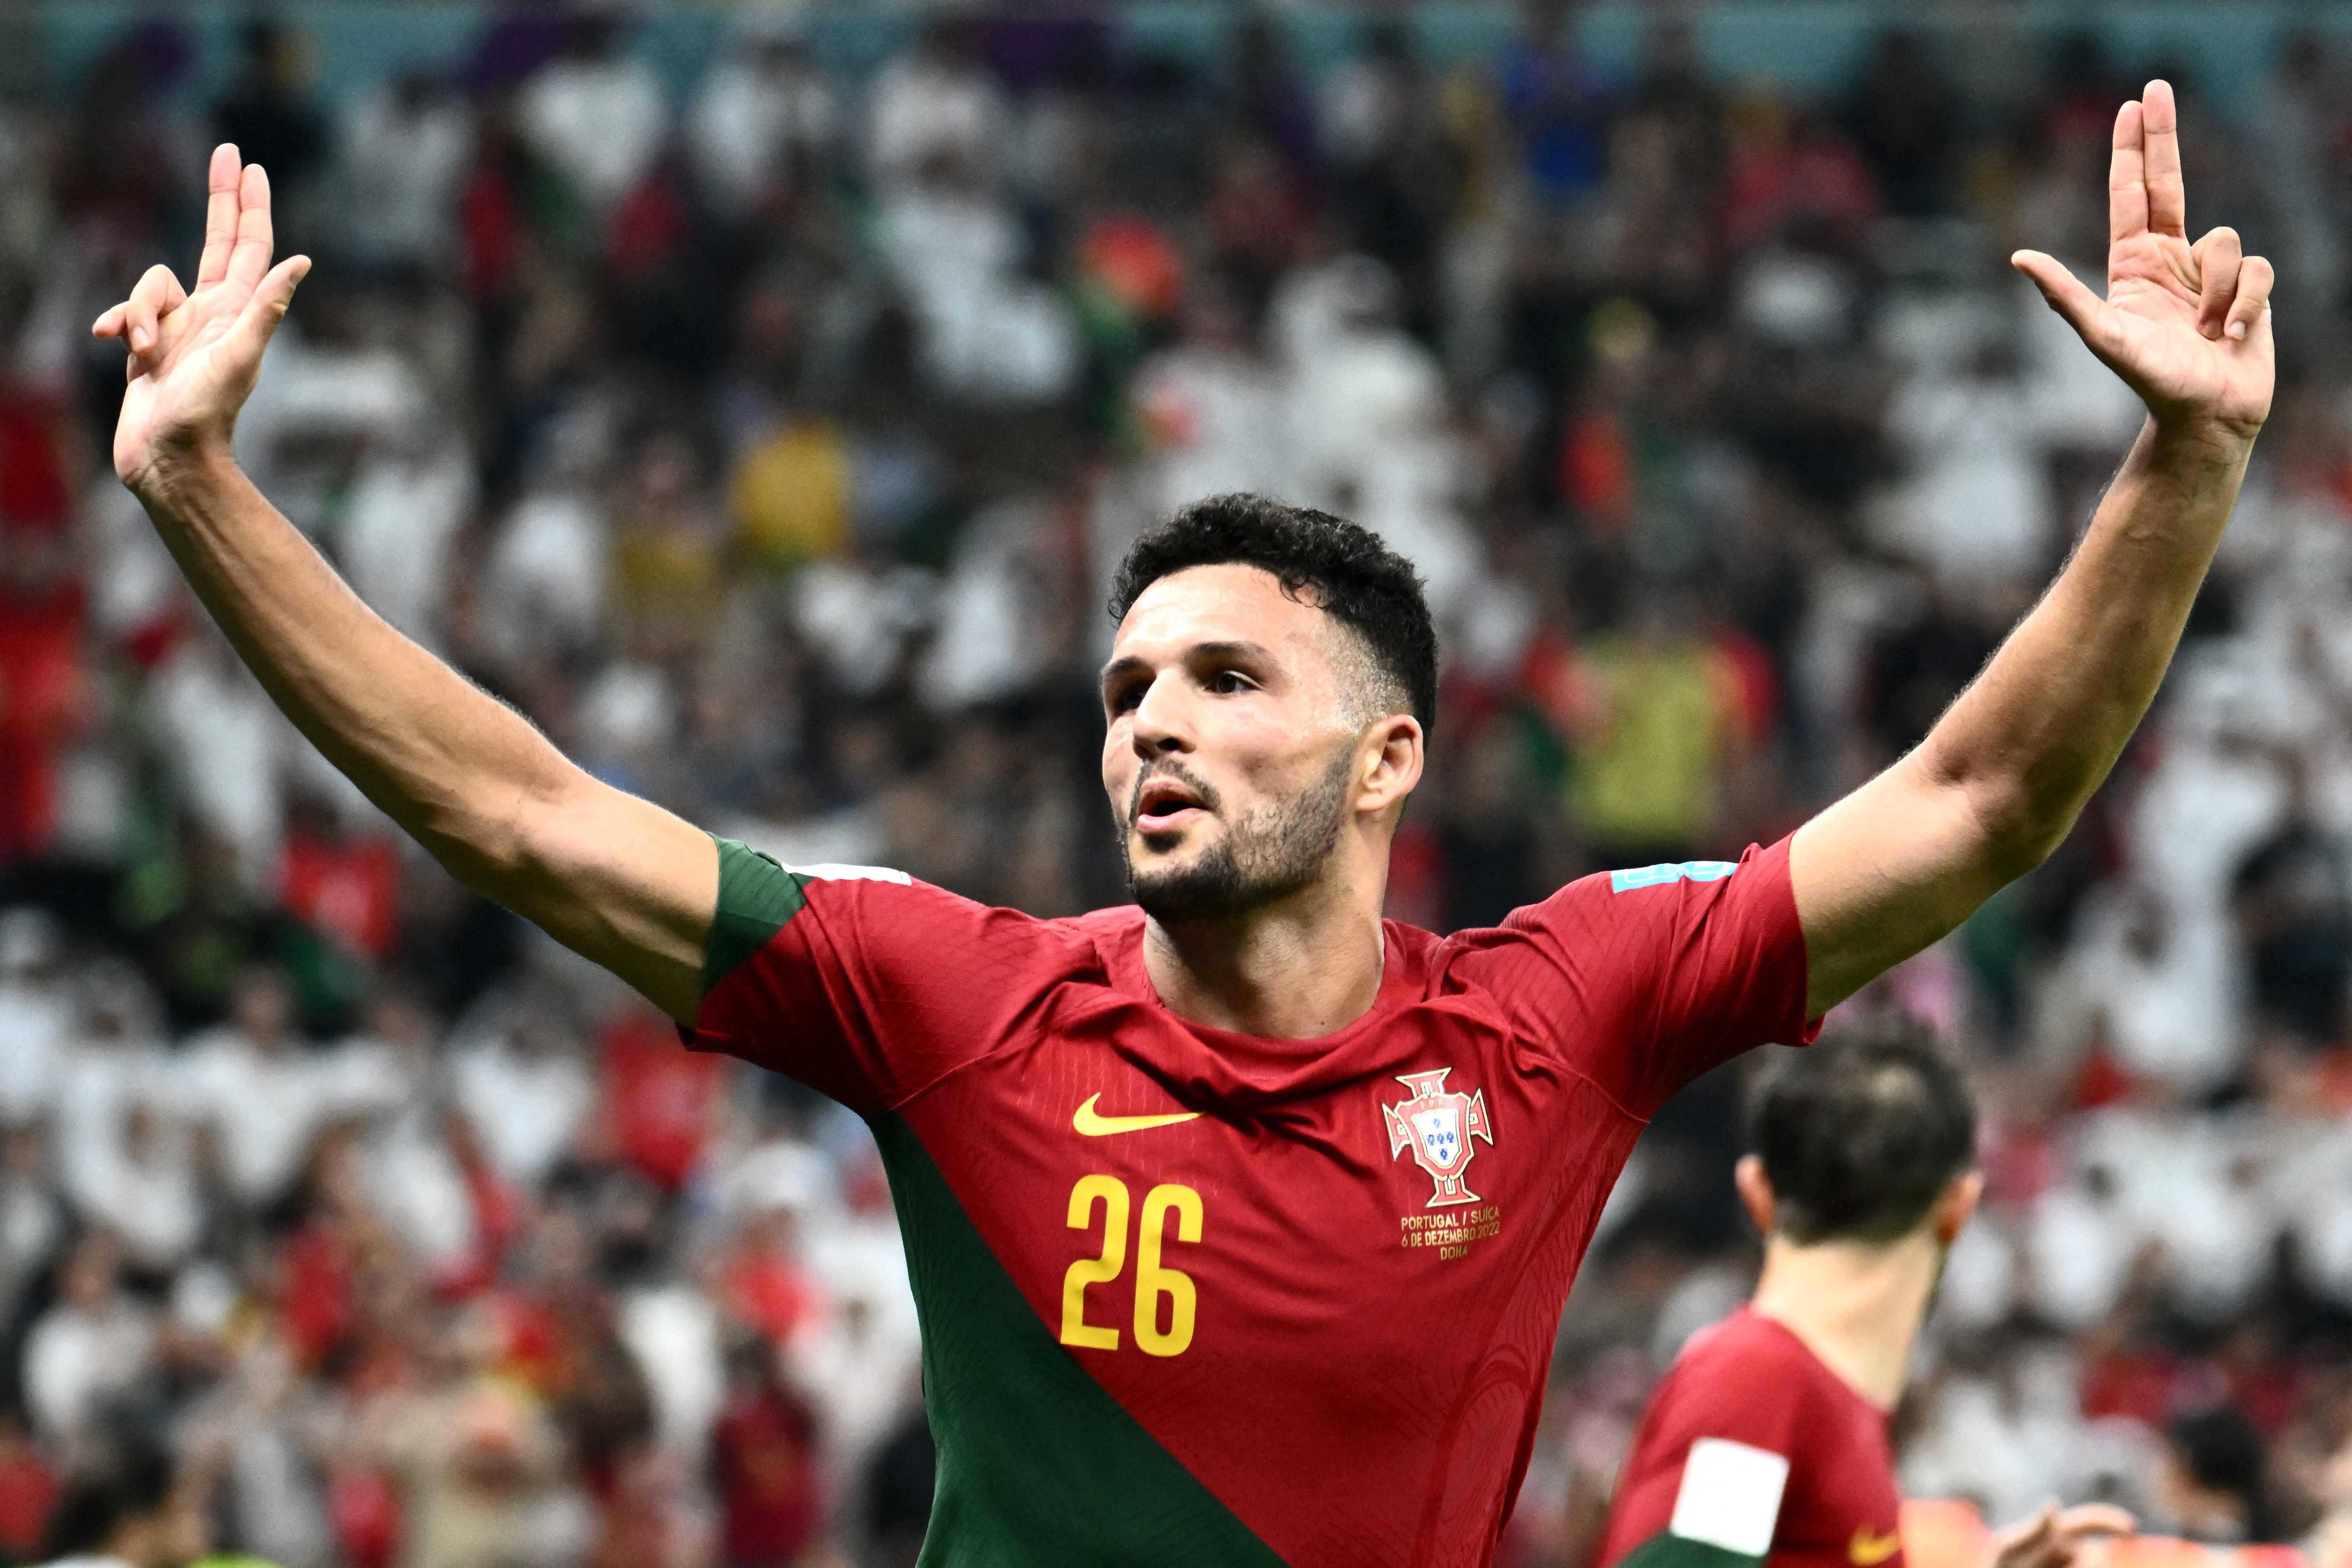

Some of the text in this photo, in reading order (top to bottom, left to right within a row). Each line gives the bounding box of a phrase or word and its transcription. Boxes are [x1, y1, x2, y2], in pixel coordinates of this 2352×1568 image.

[1401, 1213, 1459, 1231] PORTUGAL
[1463, 1211, 1466, 1226] /
[1402, 1222, 1499, 1247] 6 DE DEZEMBRO 2022
[1441, 1246, 1468, 1261] DOHA
[1060, 1174, 1204, 1357] 26
